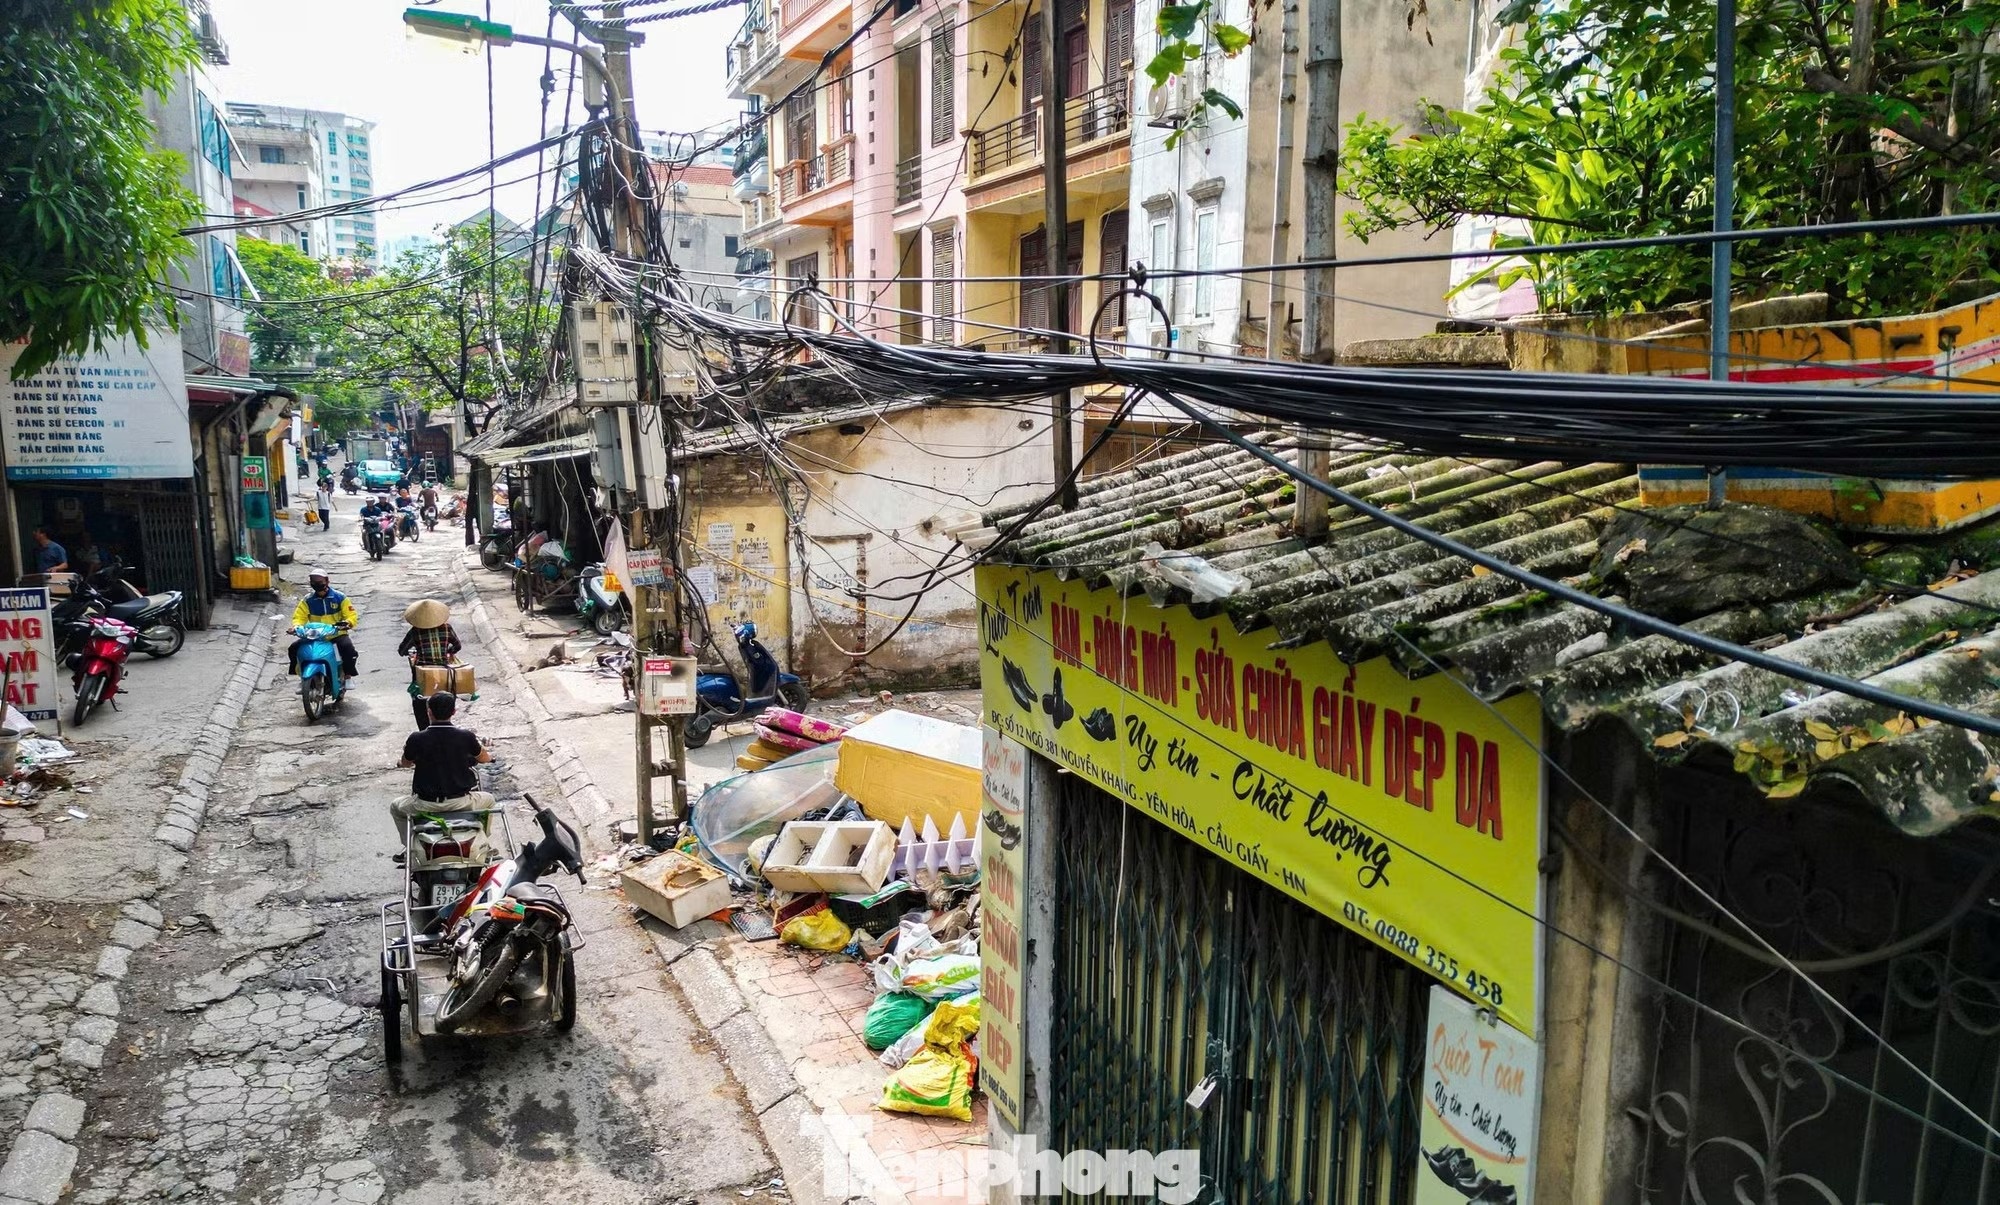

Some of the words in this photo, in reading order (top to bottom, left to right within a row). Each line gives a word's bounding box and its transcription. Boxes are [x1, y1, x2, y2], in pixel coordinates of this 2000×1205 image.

[62, 393, 104, 402] KATANA
[64, 406, 98, 415] VENUS
[65, 419, 105, 428] CERCON
[18, 432, 46, 442] PHỤC
[1, 593, 41, 609] KHÁM
[1051, 592, 1082, 671] BÁN
[1093, 605, 1139, 692] ĐÓNG
[1141, 621, 1178, 708] MỚI
[1195, 627, 1238, 733] SỬA
[1242, 657, 1307, 761] CHỮA
[1384, 697, 1447, 812] DÉP
[1455, 731, 1503, 841] DA
[1005, 714, 1015, 733] SỐ
[1015, 723, 1025, 738] 12
[1026, 731, 1043, 749] NGÕ
[1045, 738, 1058, 756] 381
[1061, 746, 1099, 779] NGUYỄN
[1101, 769, 1137, 801] KHANG
[1146, 791, 1168, 818] YÊN
[1172, 805, 1197, 835] HÒA
[1207, 822, 1232, 854] CẦU
[1236, 842, 1269, 874] GIẤY
[1282, 867, 1308, 897] HN
[1125, 714, 1158, 772] Uy
[1168, 738, 1199, 778] tín
[1232, 761, 1295, 822] Chất
[1304, 790, 1392, 889] lượng
[988, 851, 1015, 911] SỬA
[1374, 918, 1420, 957] 0988
[1424, 945, 1459, 980] 355
[1465, 969, 1504, 1006] 458
[987, 1020, 1012, 1075] DÉP
[1432, 1022, 1472, 1086] Quốc
[1471, 1102, 1492, 1135] Chất
[1493, 1112, 1517, 1164] lượng
